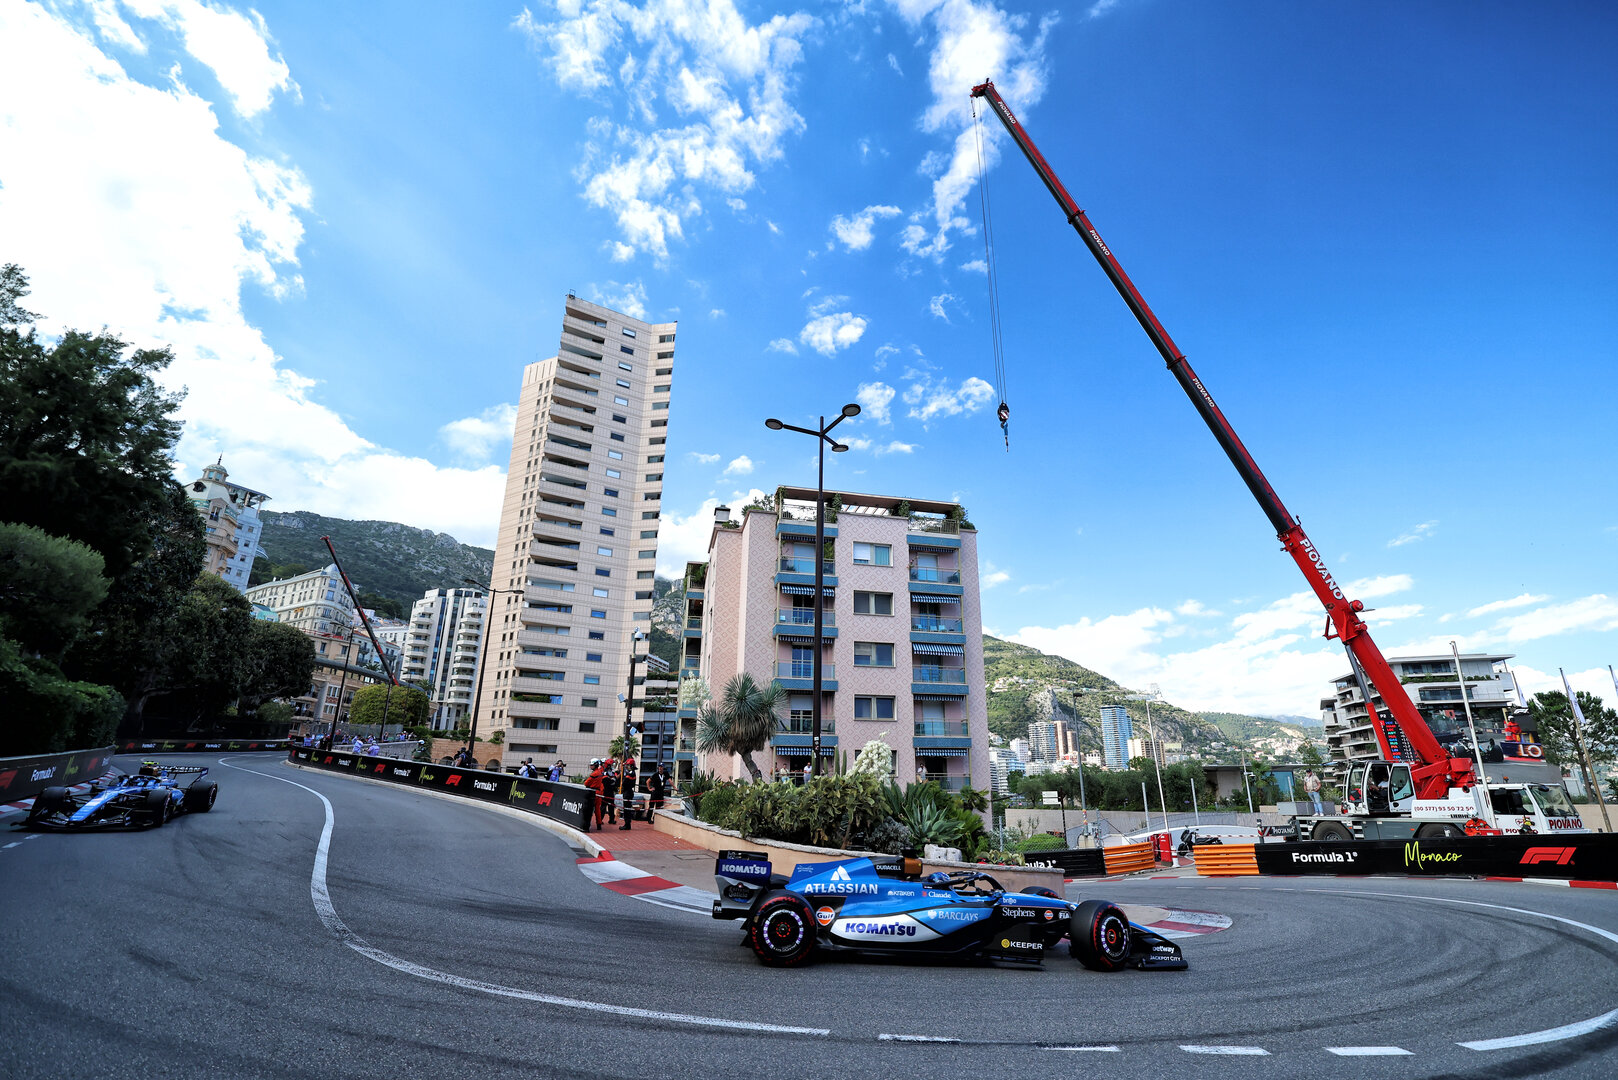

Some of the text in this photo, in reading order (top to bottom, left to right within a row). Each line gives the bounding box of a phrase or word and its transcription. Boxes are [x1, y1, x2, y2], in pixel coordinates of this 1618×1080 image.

[998, 101, 1016, 124] PIOVANO
[1089, 229, 1110, 256] PIOVANO
[1192, 377, 1215, 408] PIOVANO
[1299, 538, 1344, 600] PIOVANO
[31, 769, 52, 782] Formula
[474, 780, 491, 790] Formula
[562, 798, 577, 813] Formula
[1548, 818, 1582, 830] PIOVANO
[1292, 852, 1344, 862] Formula
[1404, 841, 1462, 870] Monaco
[722, 864, 767, 875] KOMATSU
[804, 884, 878, 894] ATLASSIAN
[816, 912, 834, 920] Gulf
[938, 910, 978, 921] BARCLAYS
[1002, 906, 1036, 918] Stephens
[845, 922, 916, 936] KOMATSU
[1010, 940, 1043, 950] KEEPER
